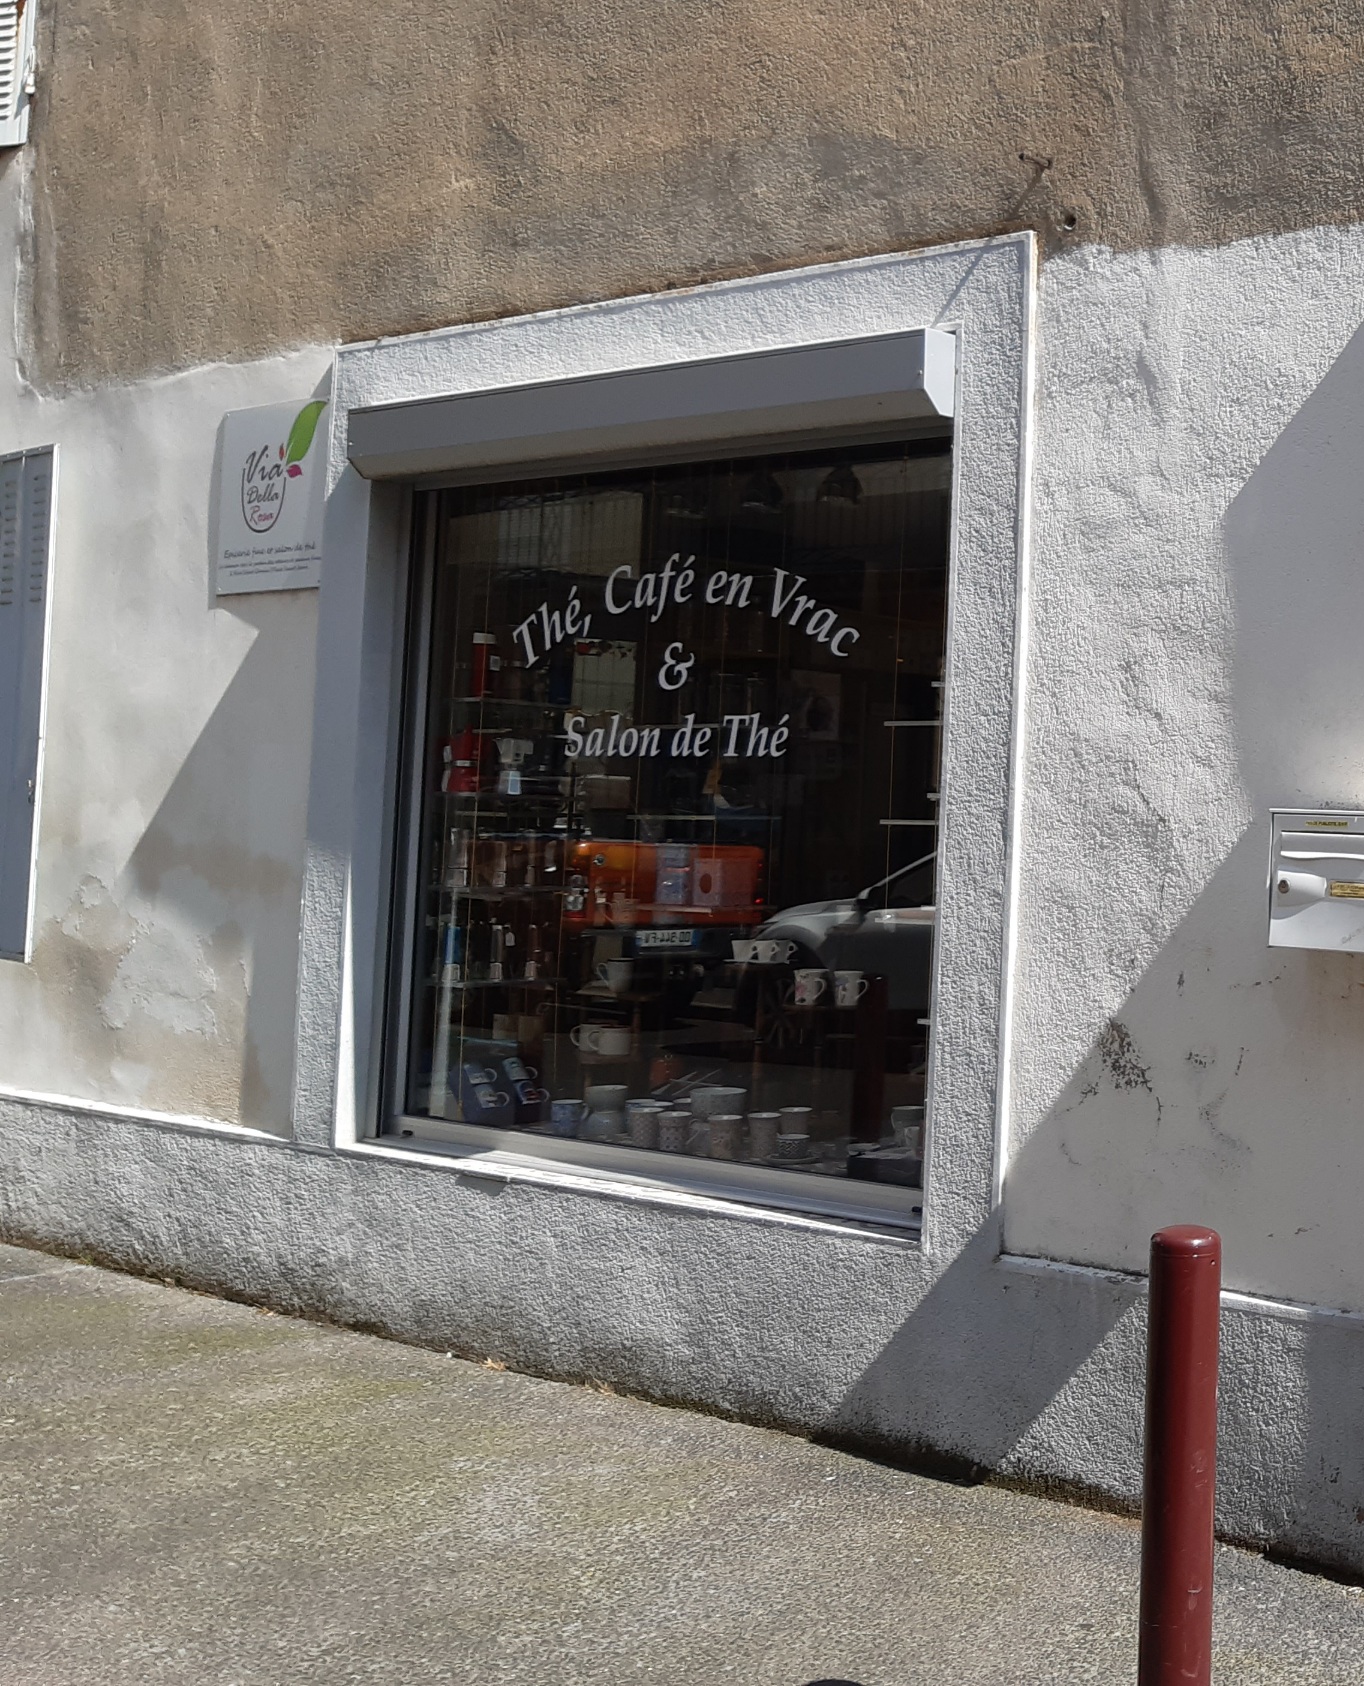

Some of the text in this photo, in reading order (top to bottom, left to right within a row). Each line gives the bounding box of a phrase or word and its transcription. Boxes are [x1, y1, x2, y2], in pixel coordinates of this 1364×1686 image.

[245, 445, 284, 484] Via
[247, 483, 279, 504] Della
[512, 552, 861, 669] Thé, Café en Vrac
[658, 641, 695, 690] &
[564, 712, 790, 757] Salon de Thé
